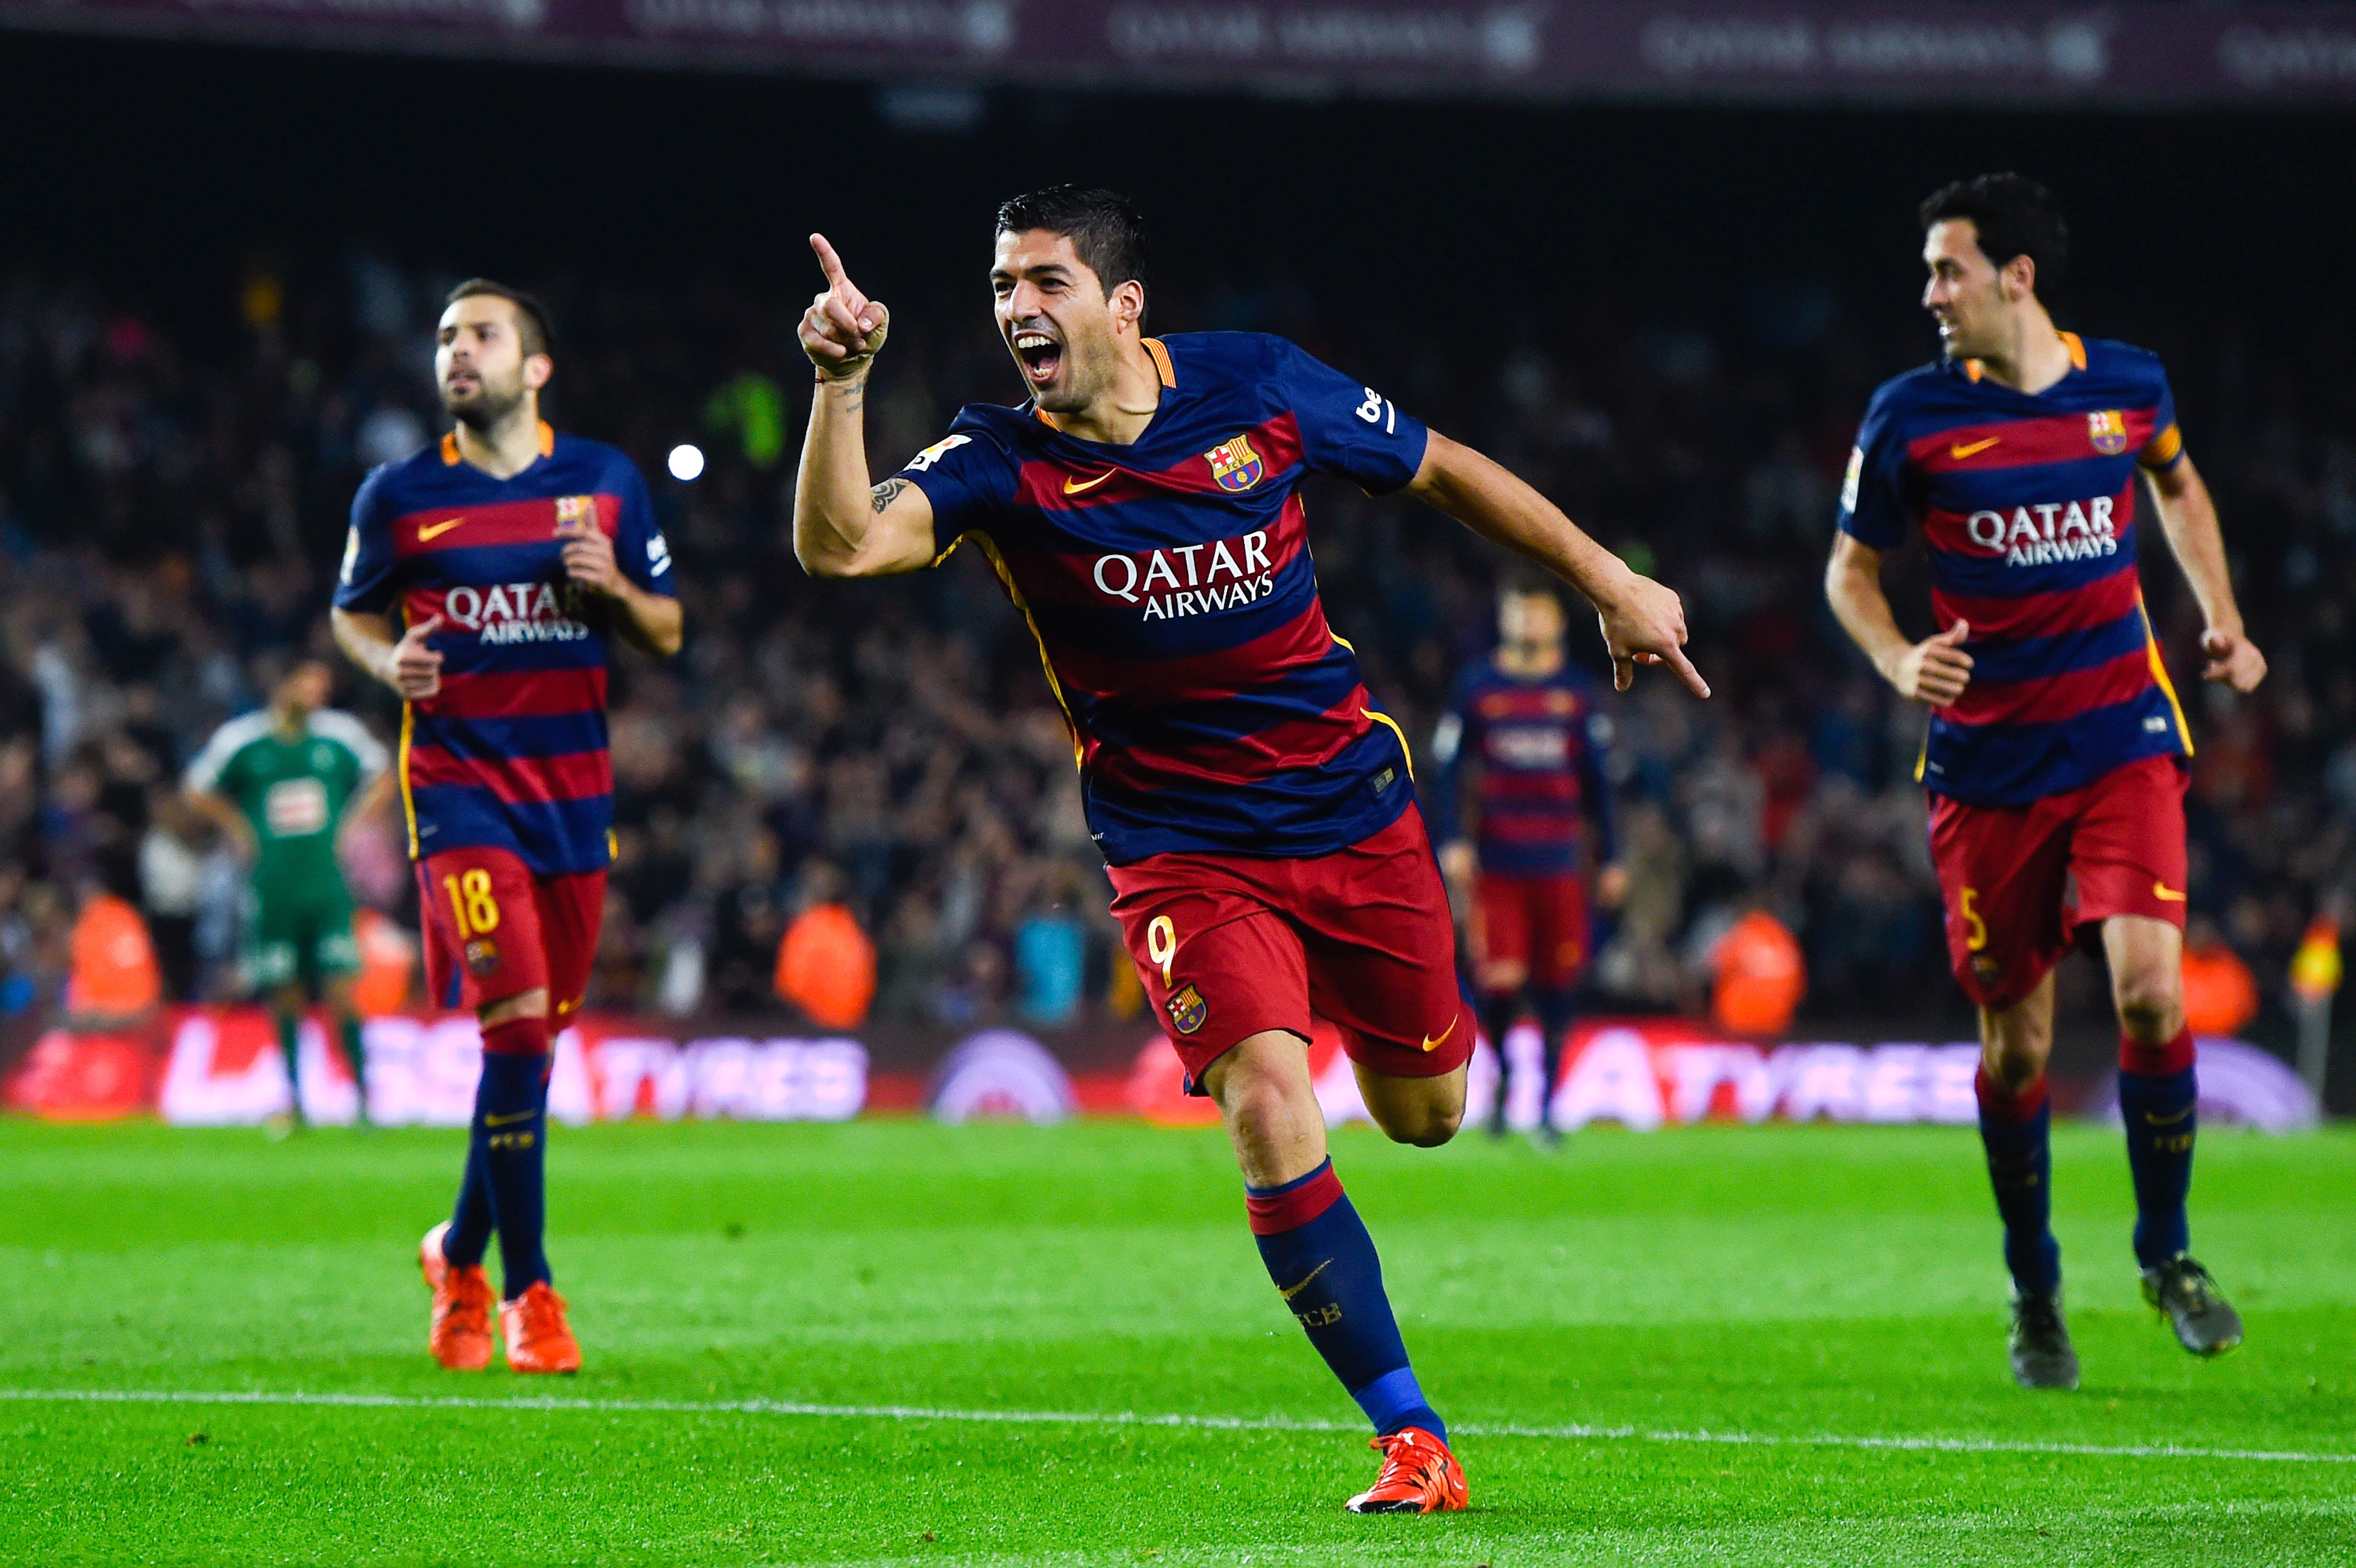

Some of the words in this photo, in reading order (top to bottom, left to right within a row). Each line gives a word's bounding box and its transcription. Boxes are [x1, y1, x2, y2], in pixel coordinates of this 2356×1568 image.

[1356, 387, 1382, 423] be
[1226, 459, 1244, 472] FCB
[1966, 496, 2114, 552] QATAR
[2006, 533, 2118, 568] AIRWAYS
[1093, 530, 1272, 603] QATAR
[1143, 570, 1273, 621] AIRWAYS
[443, 869, 500, 939] 18
[1962, 887, 1987, 951] 5
[1147, 915, 1176, 989] 9
